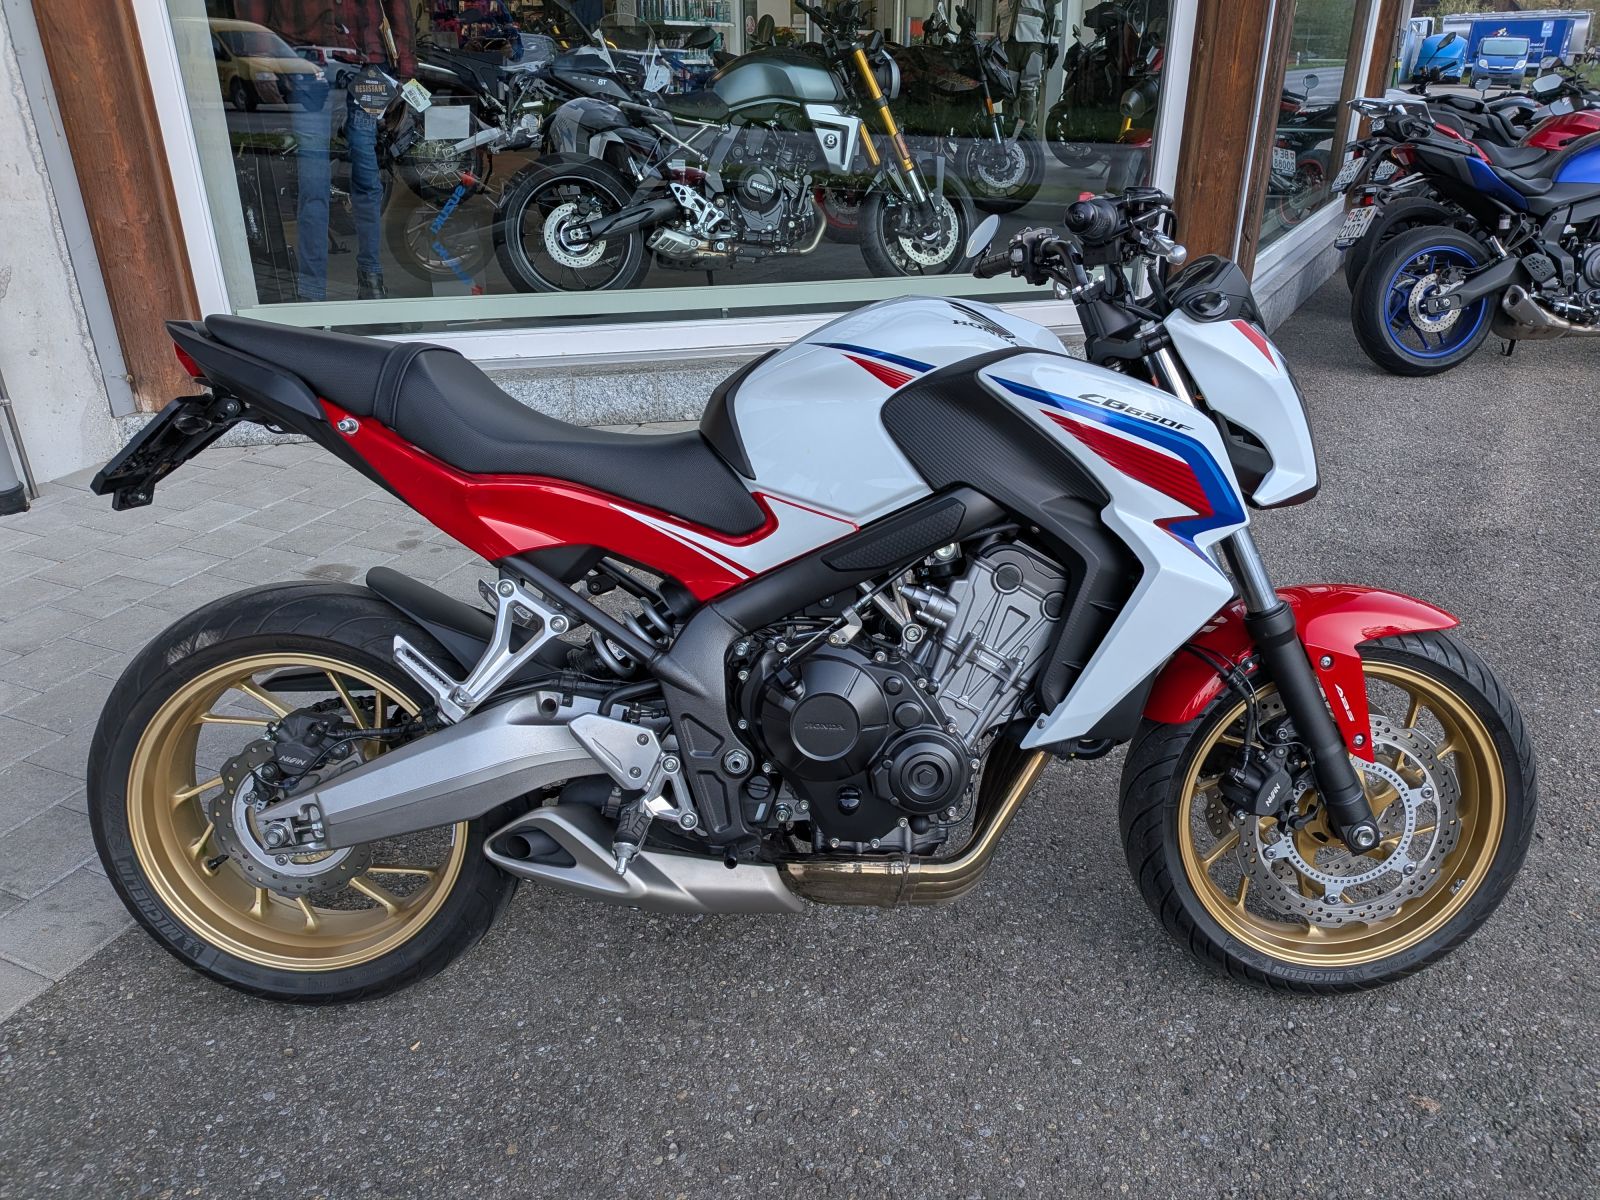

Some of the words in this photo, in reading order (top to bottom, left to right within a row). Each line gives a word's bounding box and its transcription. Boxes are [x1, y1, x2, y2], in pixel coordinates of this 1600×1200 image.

[827, 134, 835, 145] 8
[752, 182, 774, 194] SUZUKI
[1353, 209, 1366, 222] BE
[1339, 223, 1365, 238] 21071
[1078, 393, 1195, 431] CB650F
[1334, 683, 1356, 722] ABS
[803, 720, 847, 731] HONDA
[117, 861, 182, 941] MICHELIN
[1271, 965, 1345, 982] MICHELIN
